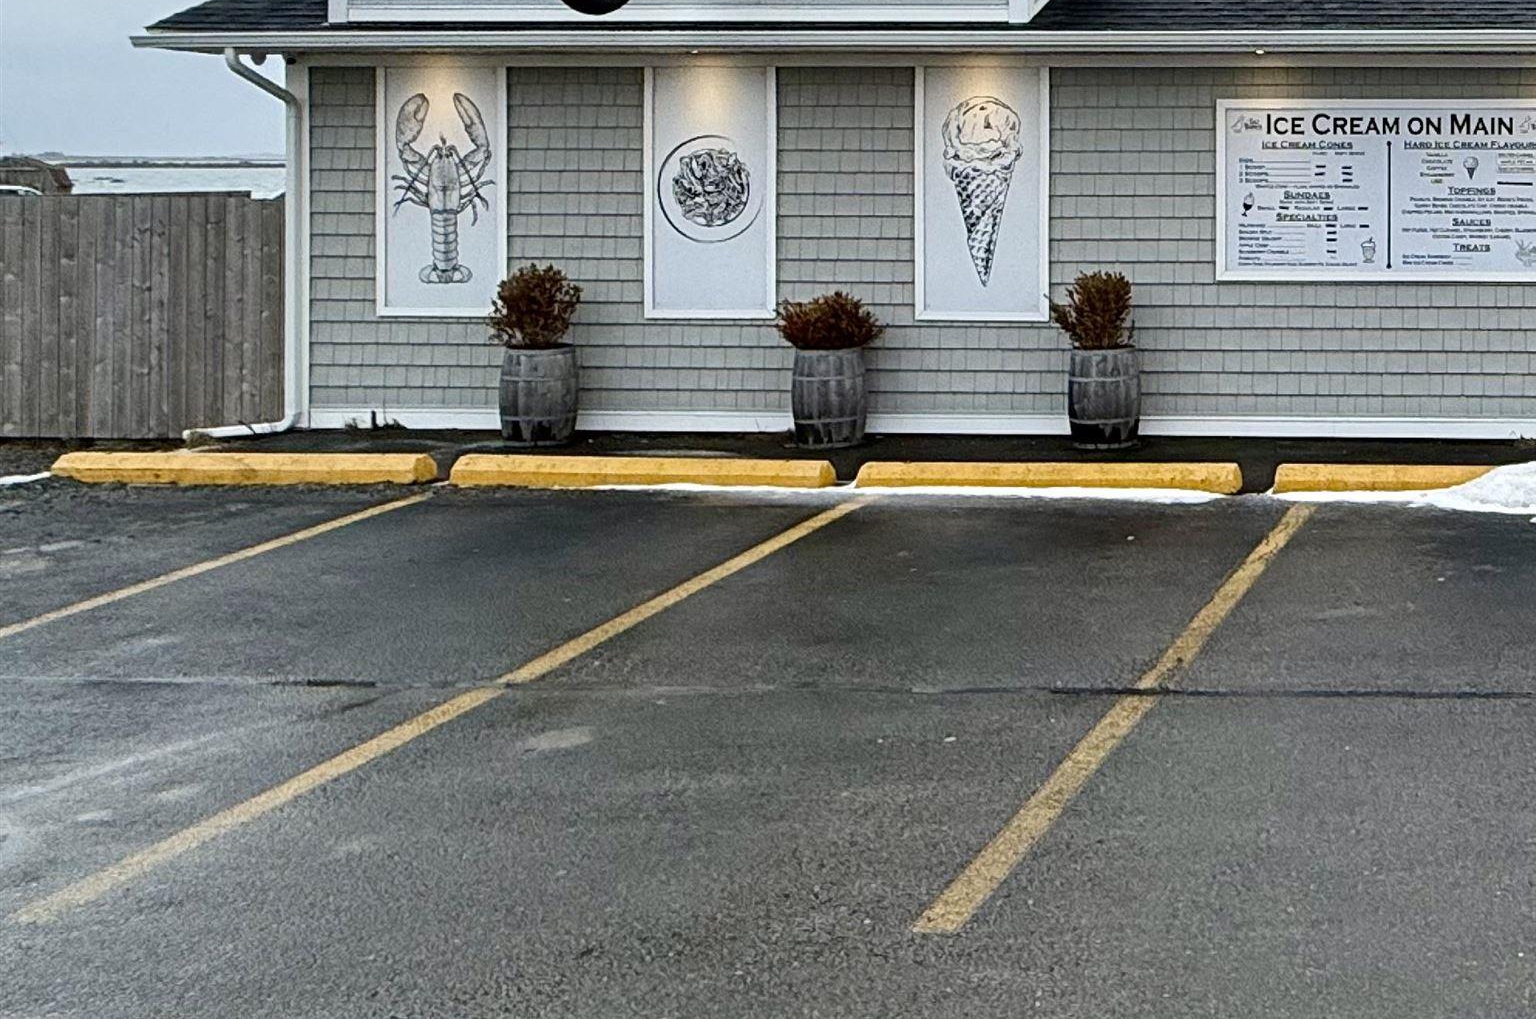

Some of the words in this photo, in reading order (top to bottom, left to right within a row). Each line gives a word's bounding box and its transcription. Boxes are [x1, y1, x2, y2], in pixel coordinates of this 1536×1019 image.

[1266, 113, 1305, 135] ICE
[1311, 113, 1400, 135] CREAM
[1407, 117, 1442, 135] ON
[1450, 113, 1514, 135] MAIN
[1262, 140, 1278, 150] ICE
[1280, 140, 1316, 150] CREAM
[1319, 140, 1353, 150] CONES
[1404, 140, 1433, 150] HARD
[1453, 140, 1488, 150] CREAM
[1283, 190, 1331, 200] SUNDAES
[1448, 186, 1496, 195] TOPPINGS
[1275, 212, 1338, 221] SPECIALTIES
[1452, 218, 1491, 226] SAUCES
[1453, 243, 1491, 252] TREATS
